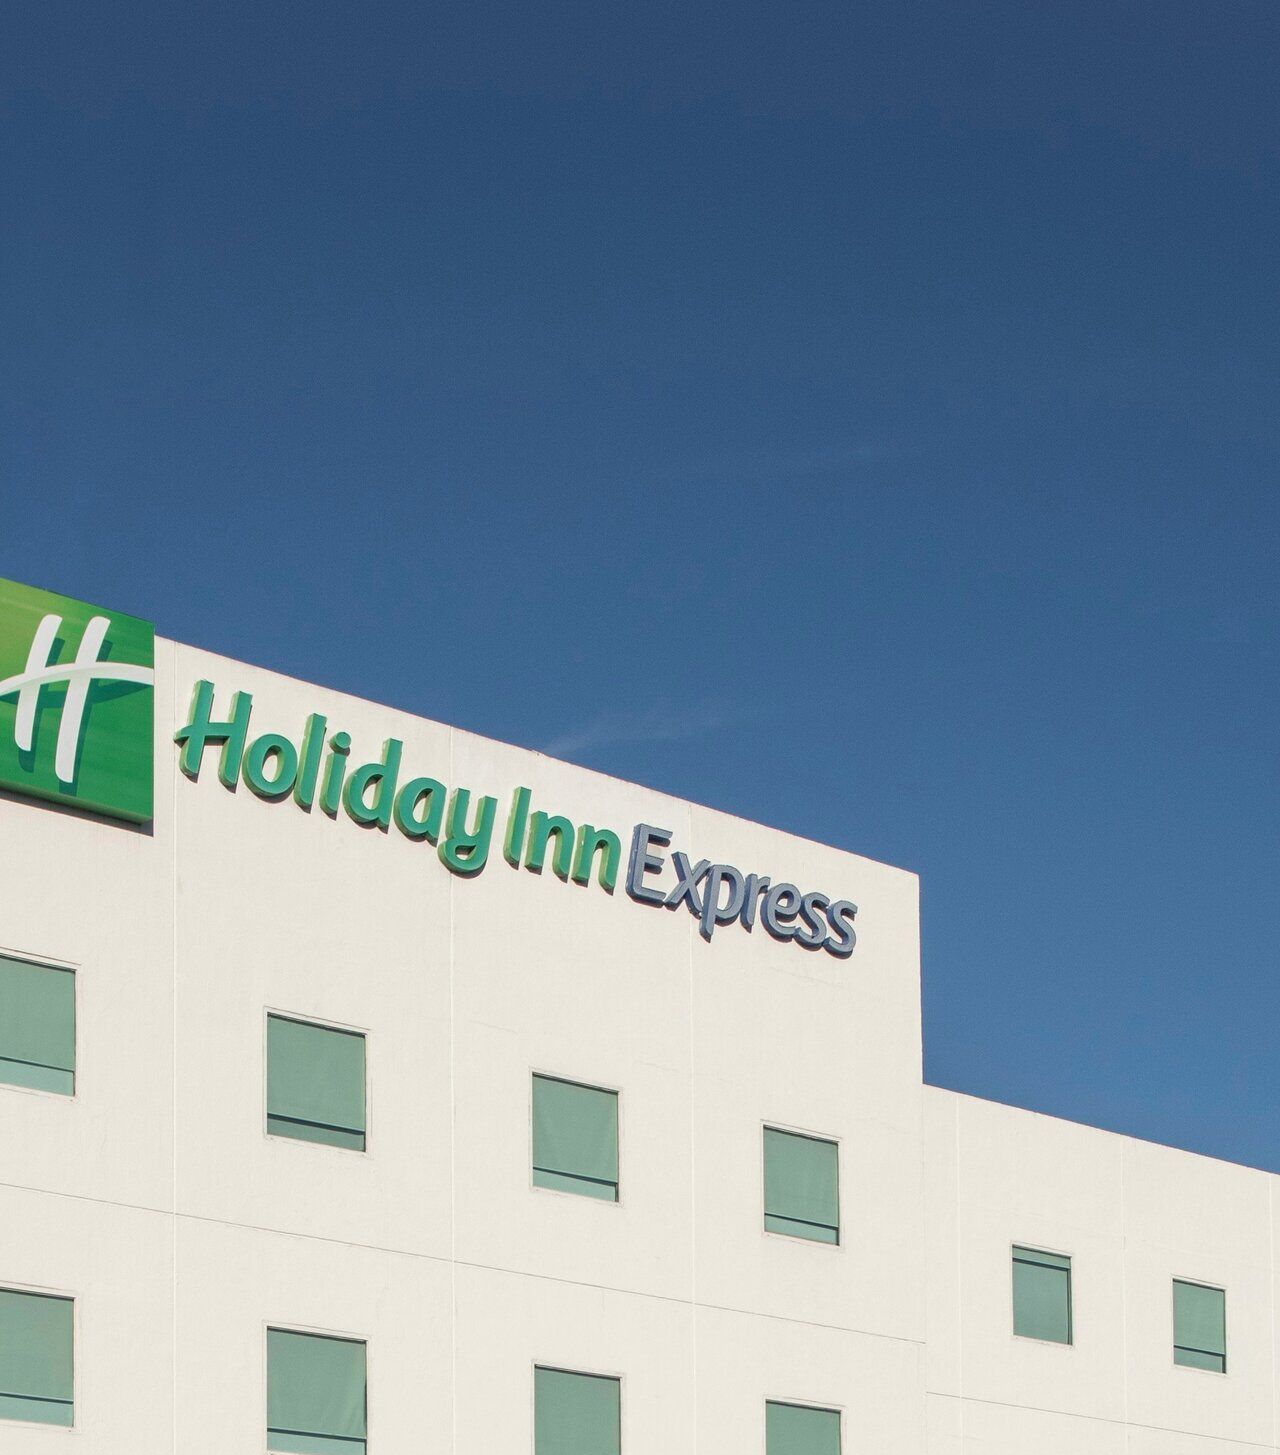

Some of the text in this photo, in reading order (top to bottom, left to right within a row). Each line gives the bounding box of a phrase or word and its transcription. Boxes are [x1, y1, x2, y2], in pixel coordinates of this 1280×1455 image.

[173, 680, 858, 957] Holiday Inn Express
